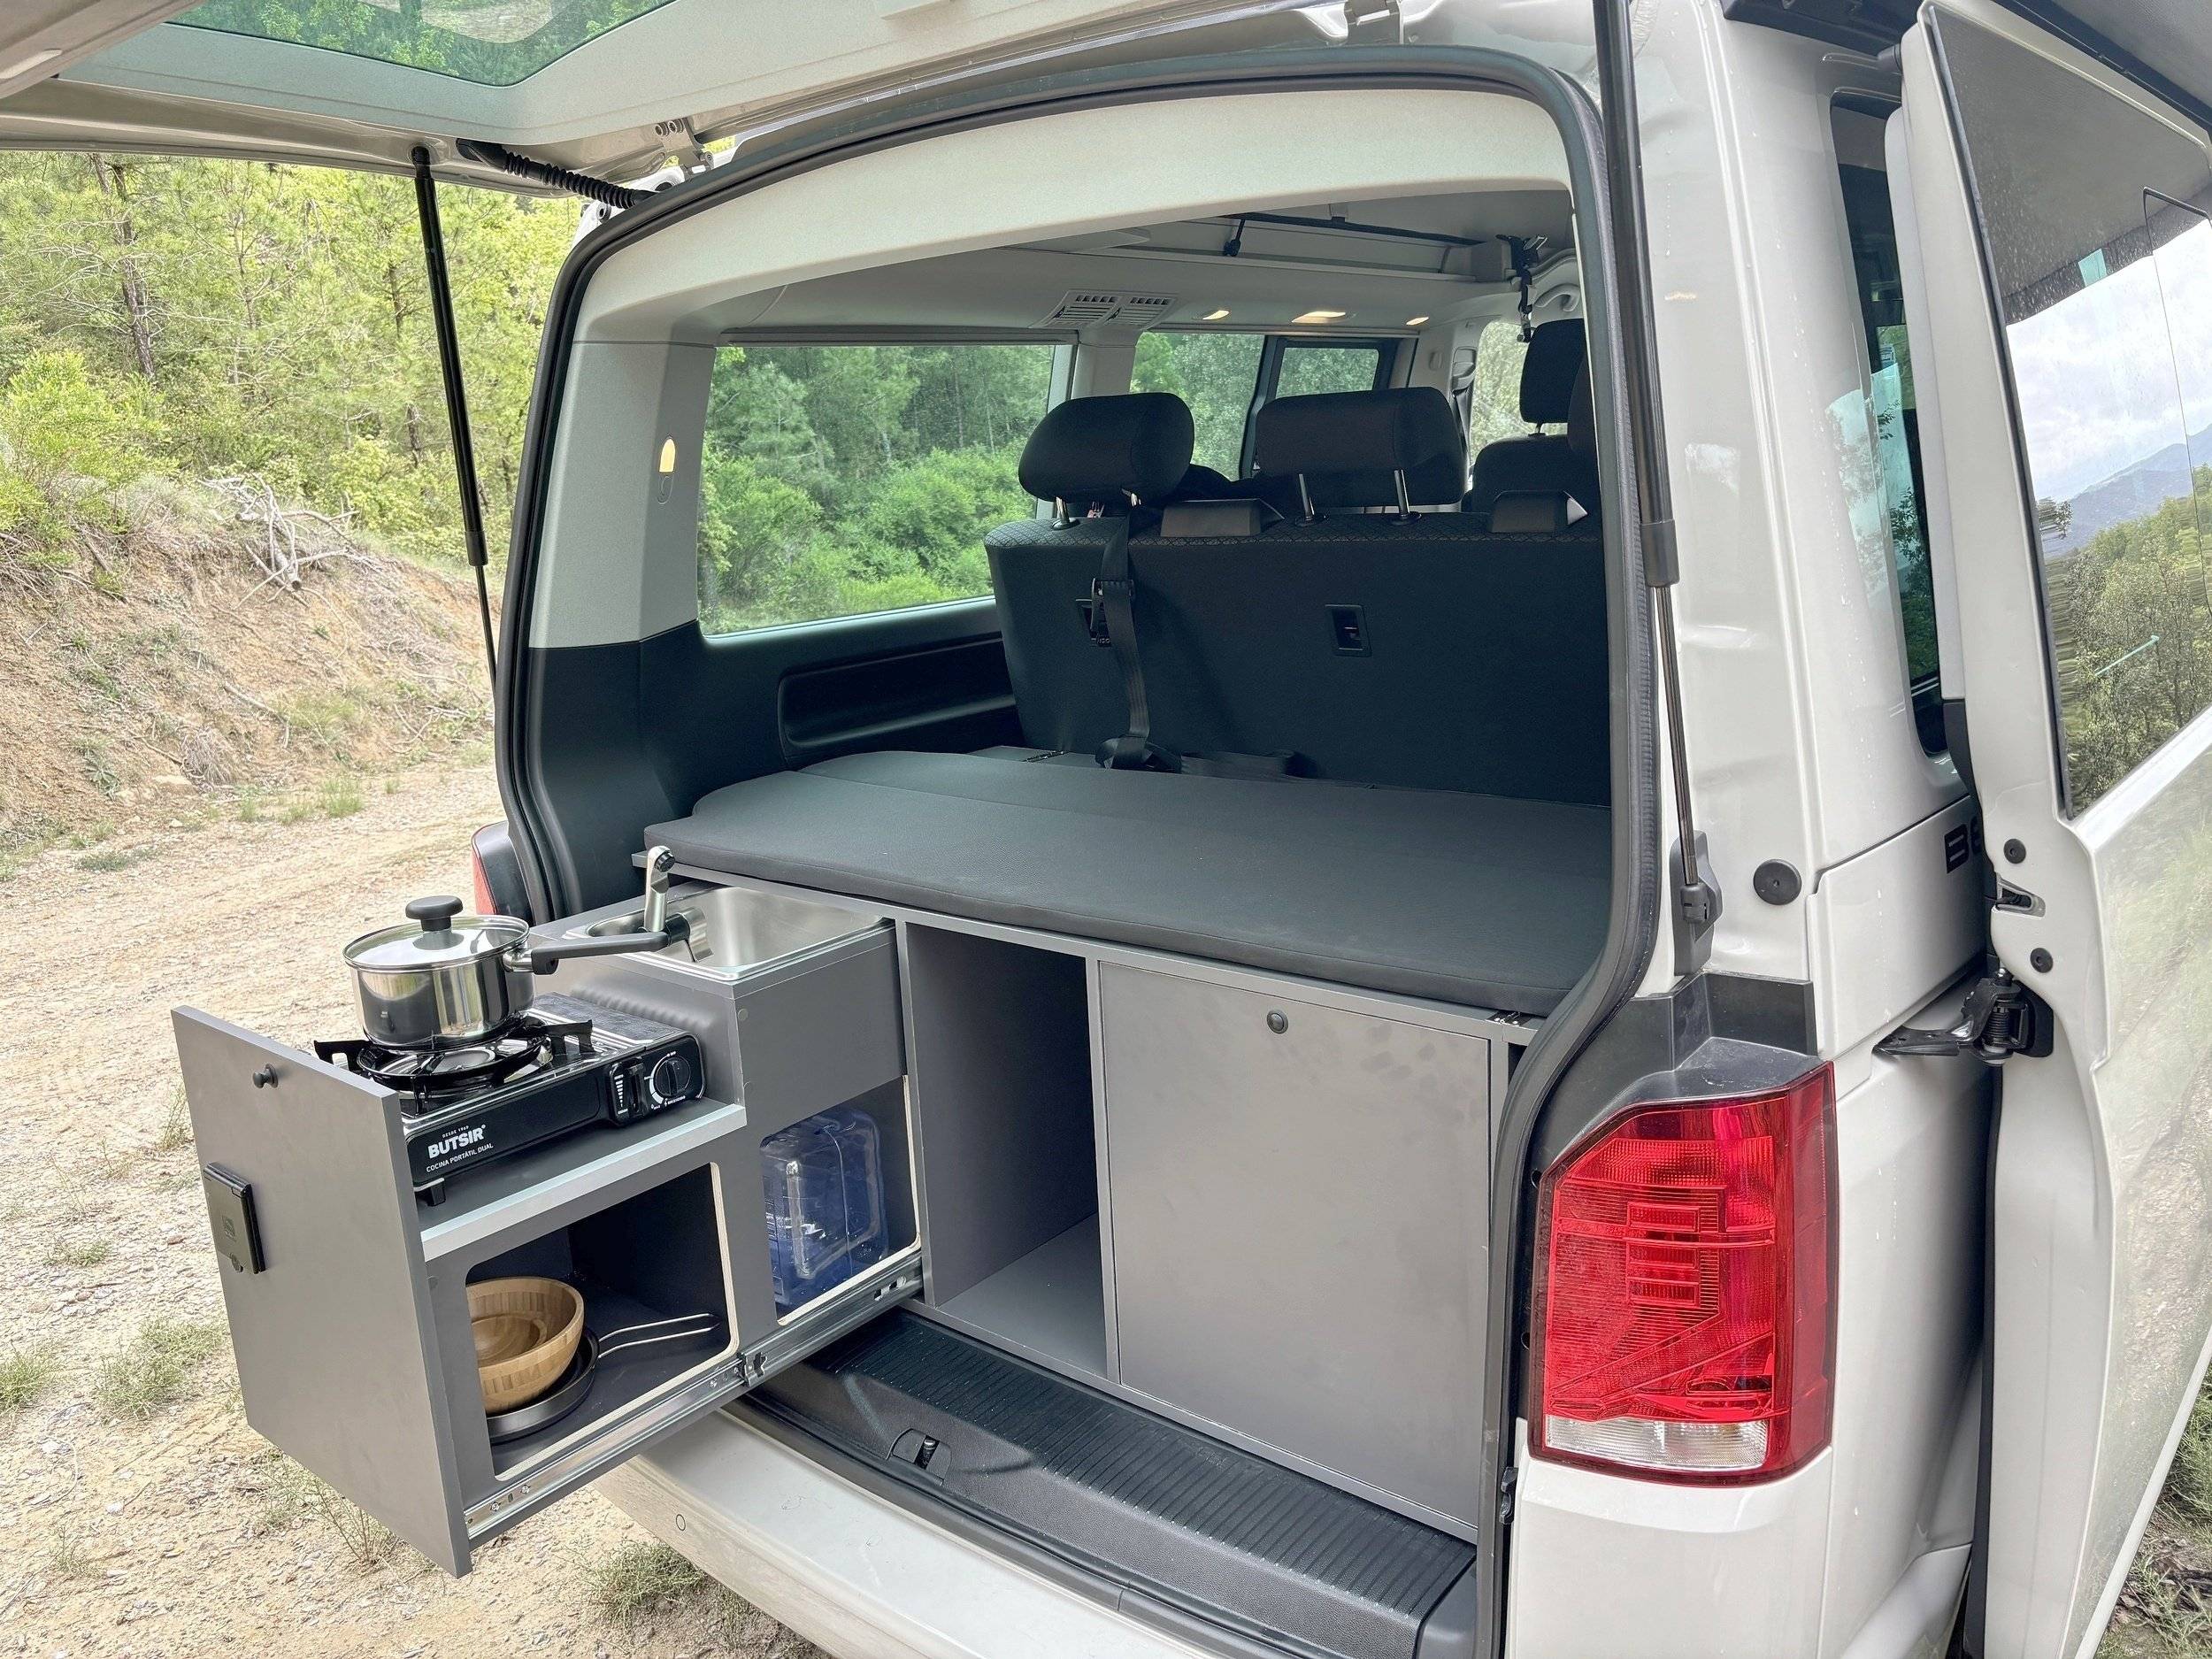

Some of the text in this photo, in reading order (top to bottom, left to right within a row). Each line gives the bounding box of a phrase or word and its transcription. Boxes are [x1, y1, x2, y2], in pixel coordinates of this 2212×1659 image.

[426, 1142, 494, 1172] COCINA PORTÁTIL DUAL
[427, 1127, 484, 1159] BUTSIR
